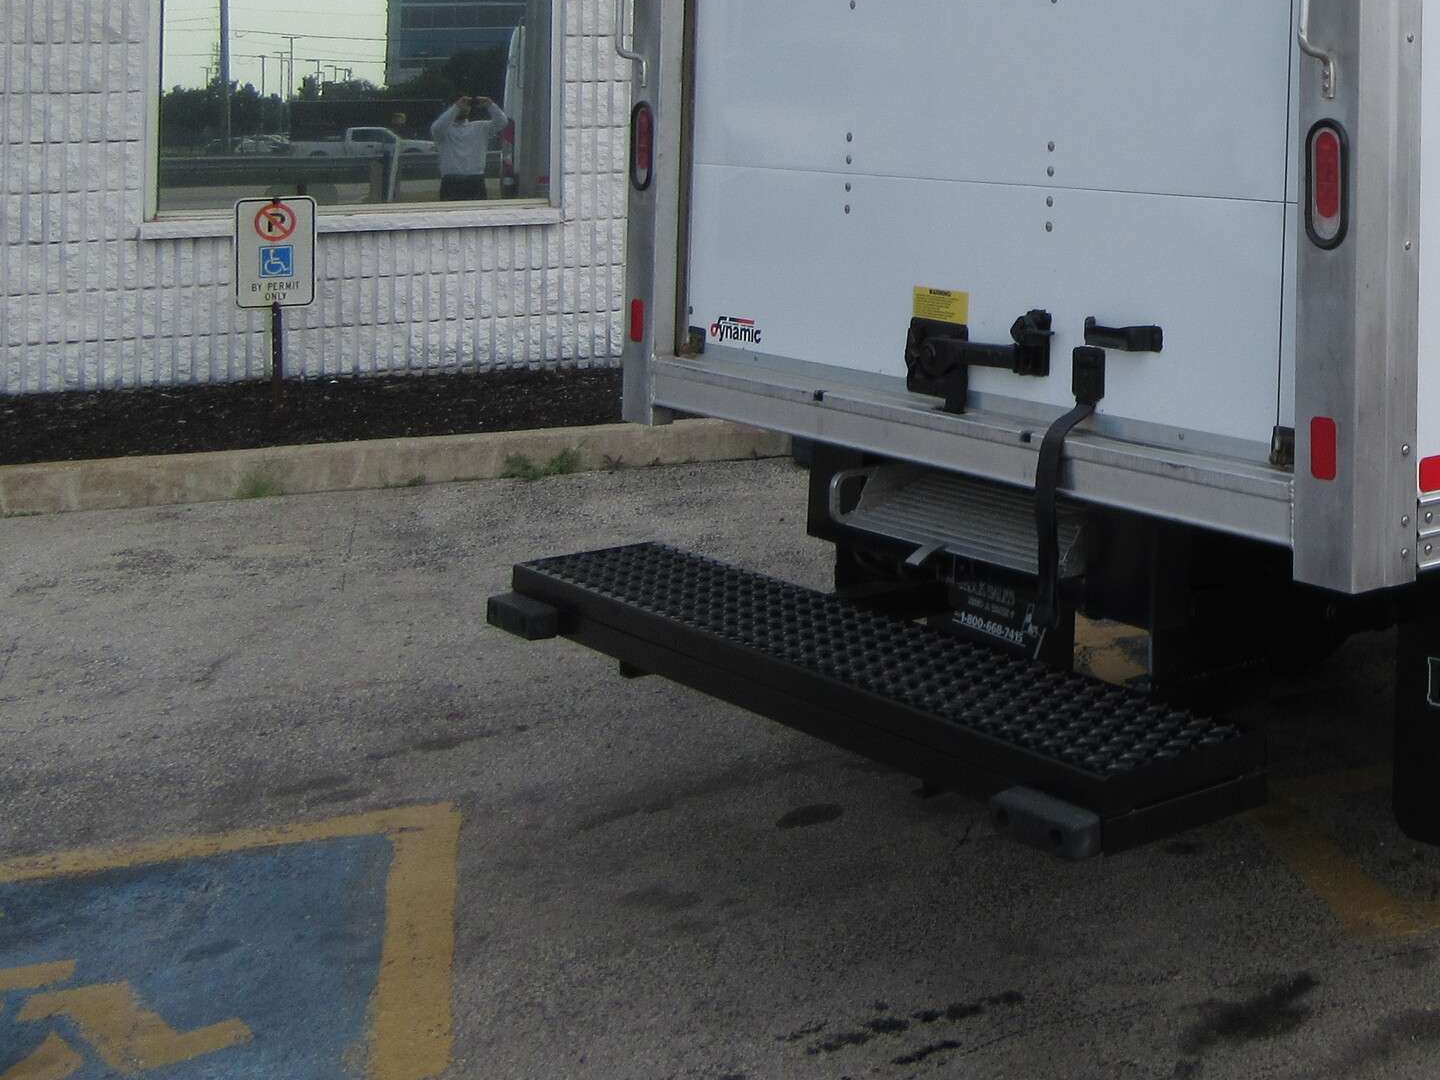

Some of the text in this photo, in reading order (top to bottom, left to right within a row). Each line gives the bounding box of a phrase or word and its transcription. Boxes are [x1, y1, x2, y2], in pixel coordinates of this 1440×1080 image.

[251, 281, 300, 292] BY PERMIT
[265, 292, 287, 301] ONLY
